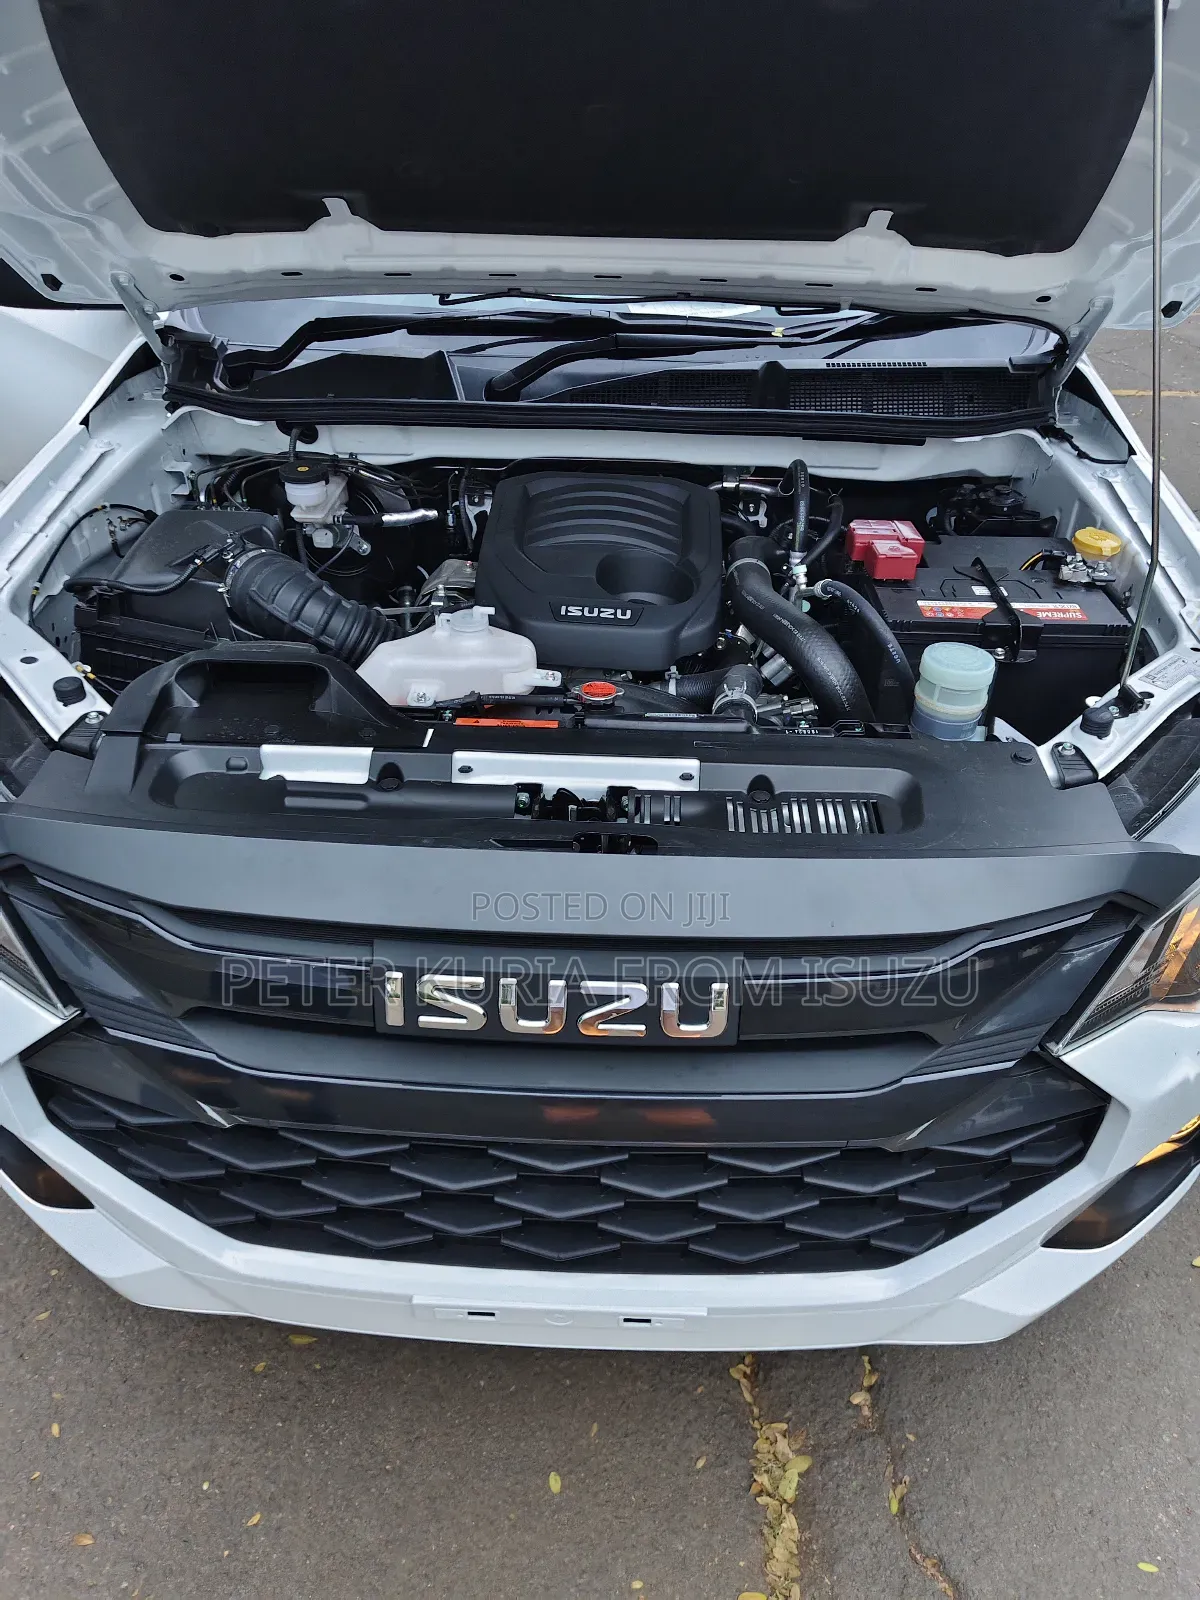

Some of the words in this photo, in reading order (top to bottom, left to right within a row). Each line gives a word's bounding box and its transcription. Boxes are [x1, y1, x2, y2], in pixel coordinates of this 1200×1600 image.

[559, 604, 633, 621] ISUZU
[1036, 611, 1083, 619] SUPREME
[385, 970, 730, 1038] ISUZU
